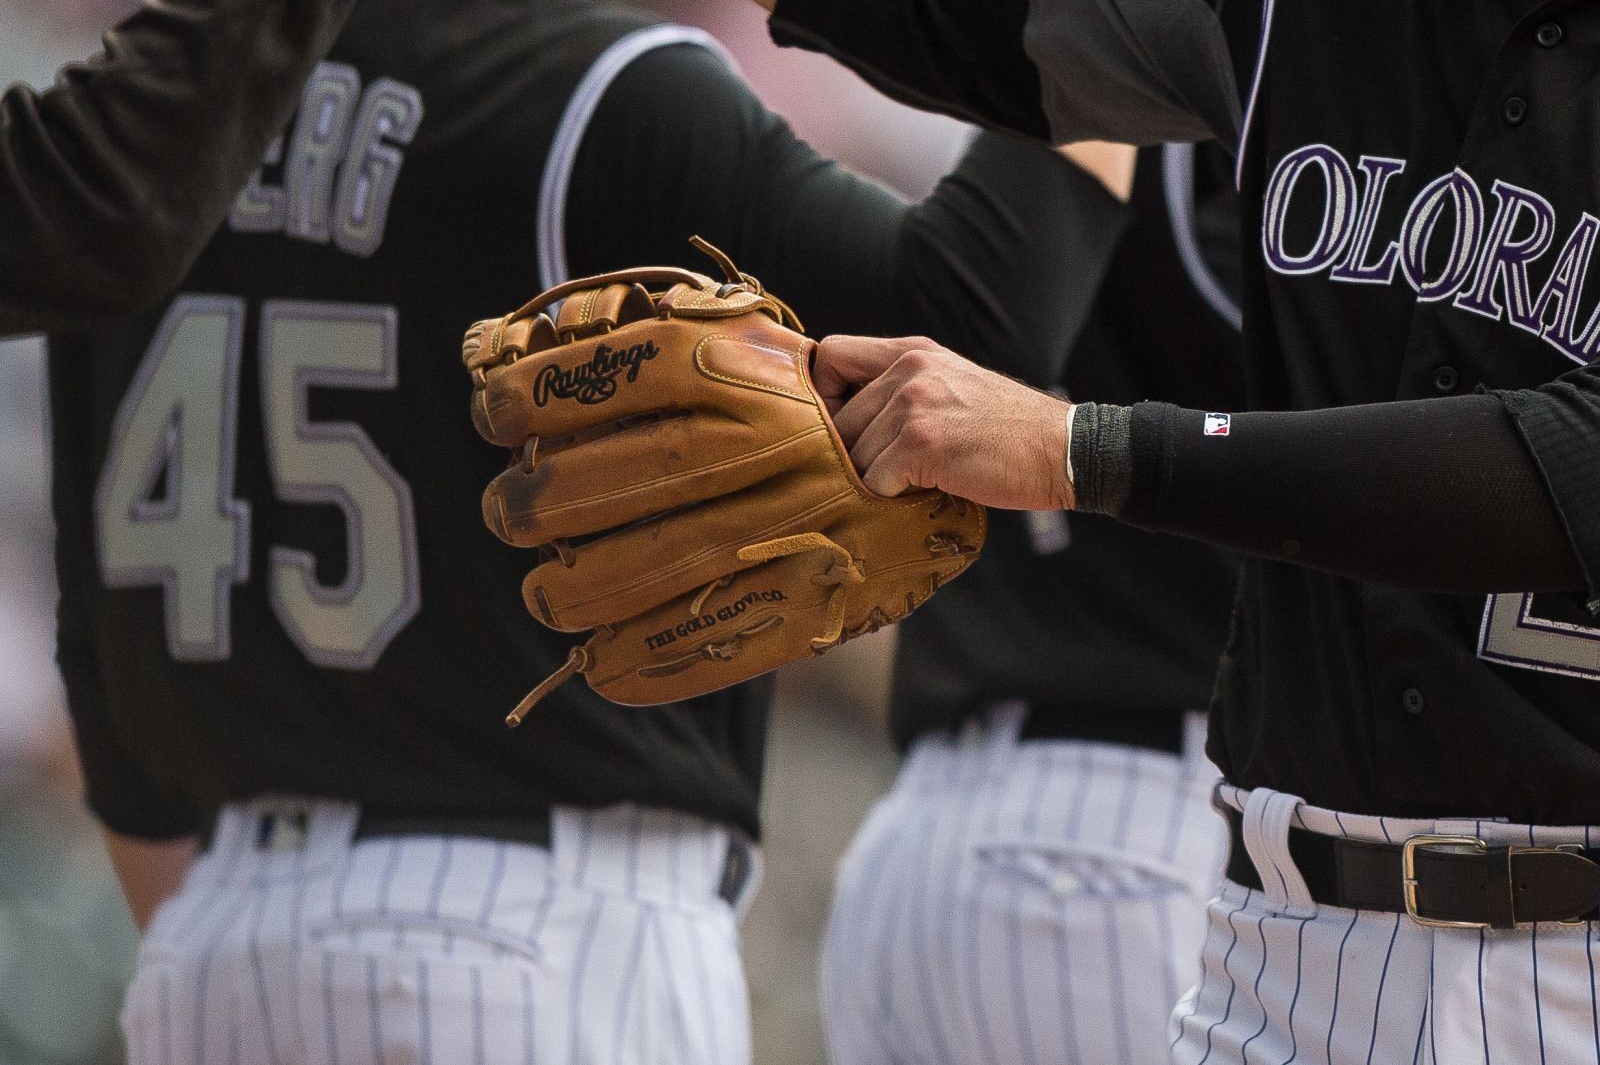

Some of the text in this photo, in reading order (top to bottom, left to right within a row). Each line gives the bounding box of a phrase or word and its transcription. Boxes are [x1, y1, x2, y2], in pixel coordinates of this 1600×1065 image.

[533, 340, 659, 408] Rawlings
[95, 295, 422, 670] 45
[644, 628, 677, 650] THE
[675, 613, 716, 638] GOLD
[761, 589, 788, 603] CO.
